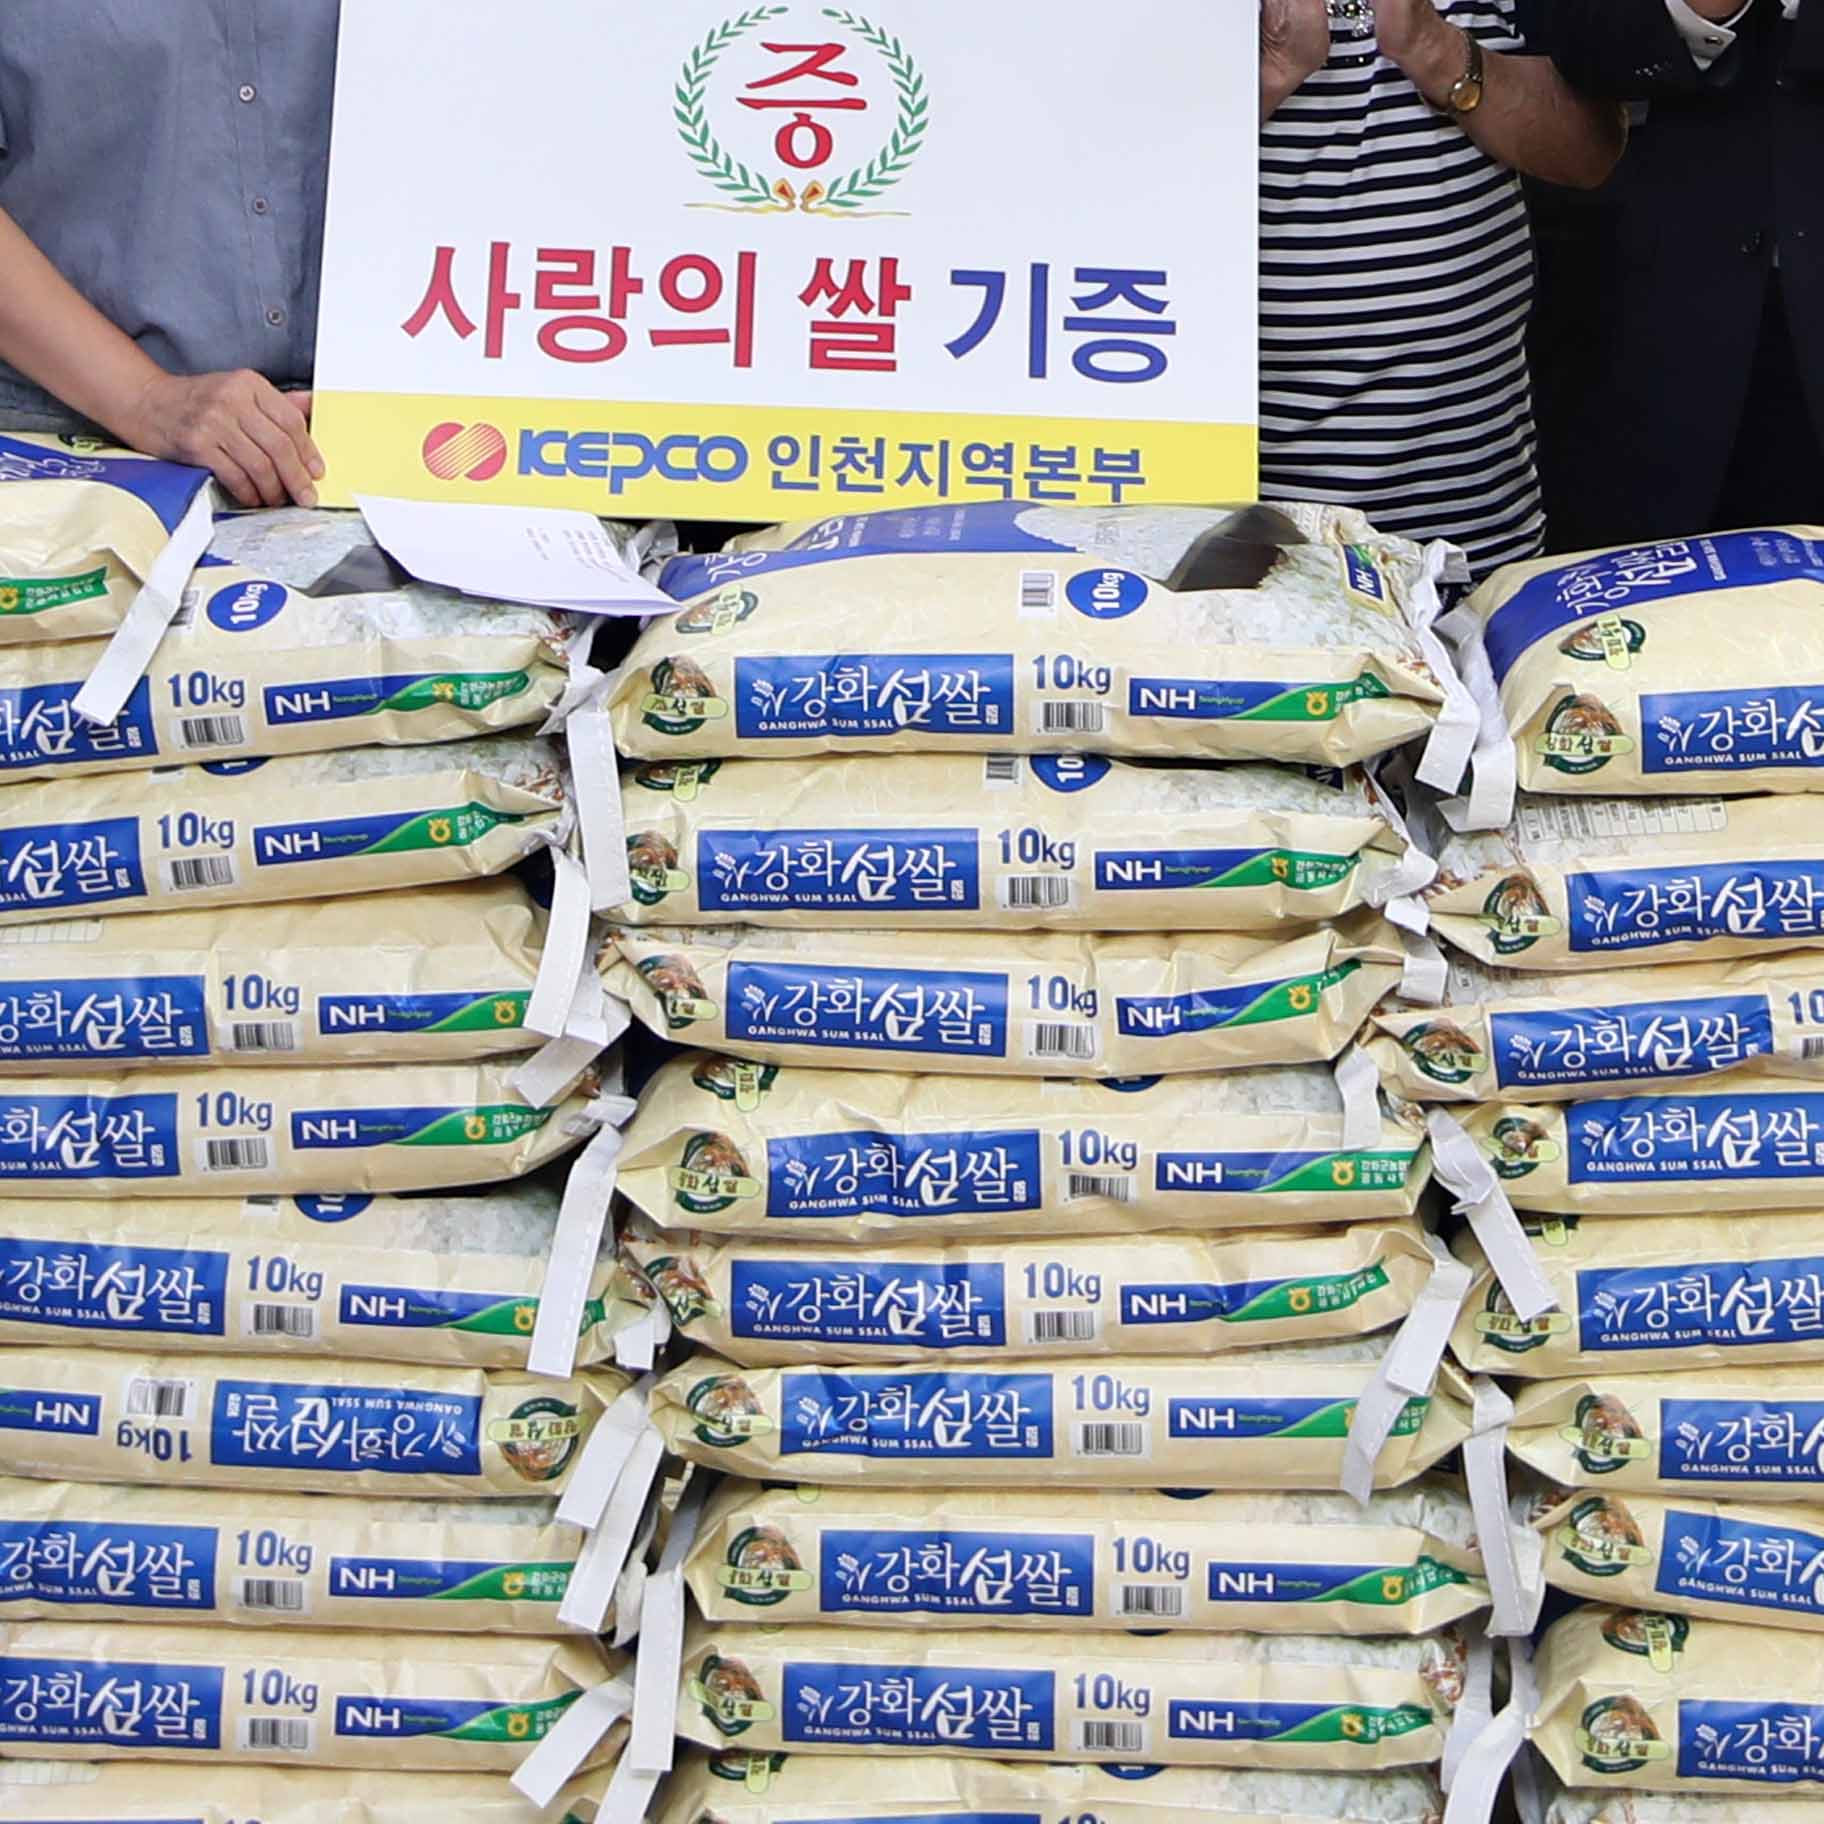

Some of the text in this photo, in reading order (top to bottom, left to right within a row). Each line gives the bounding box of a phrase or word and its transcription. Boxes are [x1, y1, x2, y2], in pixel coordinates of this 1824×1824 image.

[735, 41, 868, 169] 증
[400, 240, 1177, 384] 사랑의 쌀 기증
[517, 428, 1146, 503] KEPCO 인천지역본부
[228, 582, 269, 625] 10kg
[1091, 571, 1126, 611] 10kg
[168, 671, 244, 708] 10kg
[792, 665, 981, 724] 강화섬쌀
[1033, 655, 1110, 695] 10kg
[275, 691, 330, 715] NH
[1141, 688, 1195, 709] NH
[759, 717, 894, 732] GANGHWA SUM SSAL
[158, 812, 234, 849] 10kg
[265, 832, 320, 856] NH
[999, 828, 1075, 870] 10kg
[754, 843, 964, 901] 강화섬쌀
[1106, 861, 1161, 881] NH
[1624, 875, 1824, 933] 강화섬쌀
[223, 975, 299, 1015] 10kg
[330, 1005, 384, 1025] NH
[784, 985, 974, 1044] 강화섬쌀
[1028, 976, 1097, 1018] 10kg
[1128, 1001, 1180, 1028] NH
[1549, 1009, 1750, 1070] 강화섬쌀
[197, 1092, 272, 1131] 10kg
[302, 1119, 356, 1140] NH
[1059, 1130, 1137, 1171] 10kg
[1621, 1107, 1820, 1168] 강화섬쌀
[824, 1145, 1017, 1206] 강화섬쌀
[1168, 1162, 1222, 1183] NH
[1586, 1159, 1724, 1172] GANGHWA SUM SSAL
[8, 1254, 210, 1324] 강화섬쌀
[248, 1256, 322, 1301] 10kg
[1024, 1263, 1101, 1304] 10kg
[351, 1295, 405, 1318] NH
[787, 1273, 983, 1338] 강화섬쌀
[1132, 1294, 1186, 1315] NH
[36, 1401, 89, 1425] NH
[839, 1385, 1038, 1448] 강화섬쌀
[1072, 1375, 1150, 1417] 10kg
[1180, 1408, 1234, 1429] NH
[117, 1421, 192, 1462] 10kg
[0, 1532, 200, 1599] 강화섬쌀
[237, 1531, 312, 1575] 10kg
[1113, 1537, 1189, 1580] 10kg
[340, 1567, 394, 1589] NH
[876, 1543, 1078, 1606] 강화섬쌀
[1220, 1573, 1273, 1593] NH
[6, 1671, 206, 1739] 강화섬쌀
[244, 1670, 317, 1713] 10kg
[839, 1677, 1039, 1740] 강화섬쌀
[1075, 1675, 1150, 1717] 10kg
[346, 1707, 400, 1728] NH
[1180, 1710, 1233, 1731] NH
